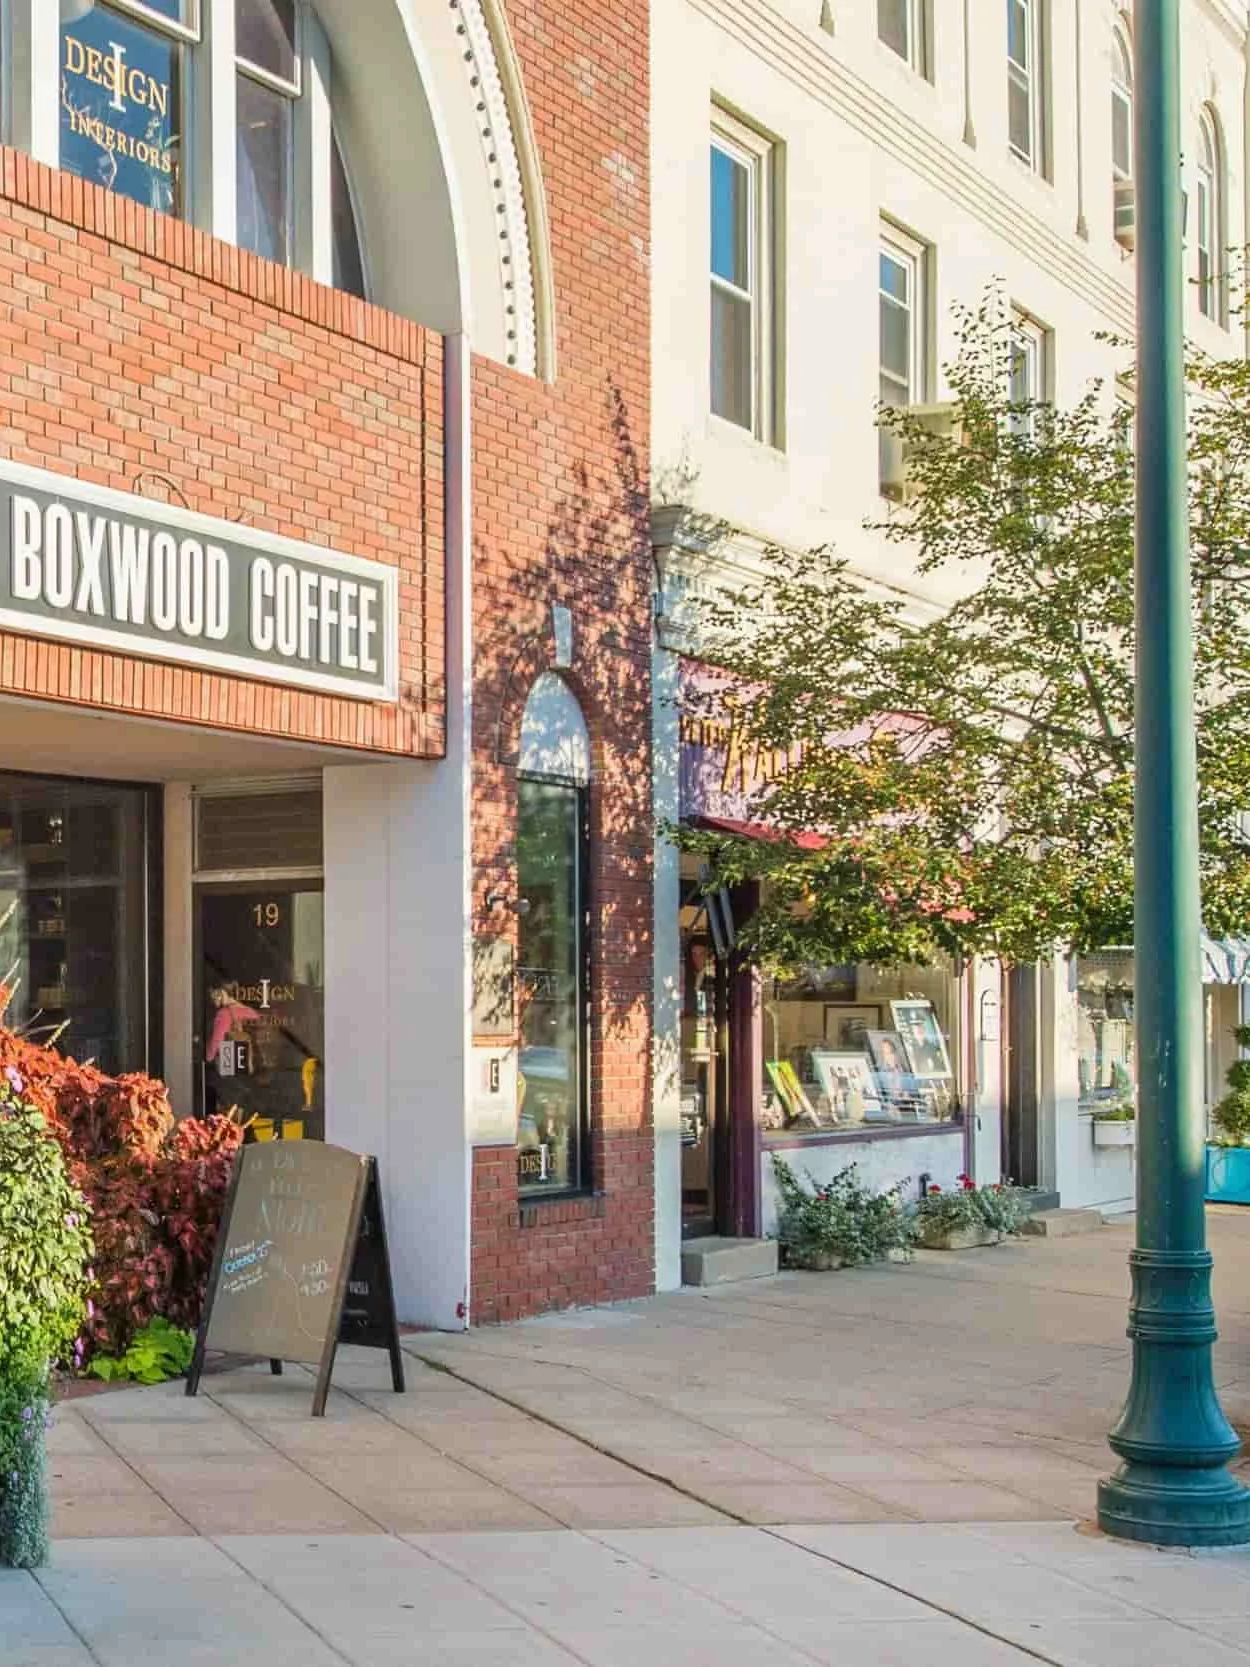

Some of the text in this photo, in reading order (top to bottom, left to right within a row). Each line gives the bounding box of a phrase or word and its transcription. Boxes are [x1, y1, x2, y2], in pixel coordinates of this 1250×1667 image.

[65, 36, 168, 117] DESIGN
[68, 110, 172, 174] INTERIORS
[11, 495, 377, 673] BOXWOOD COFFEE
[253, 903, 279, 927] 19
